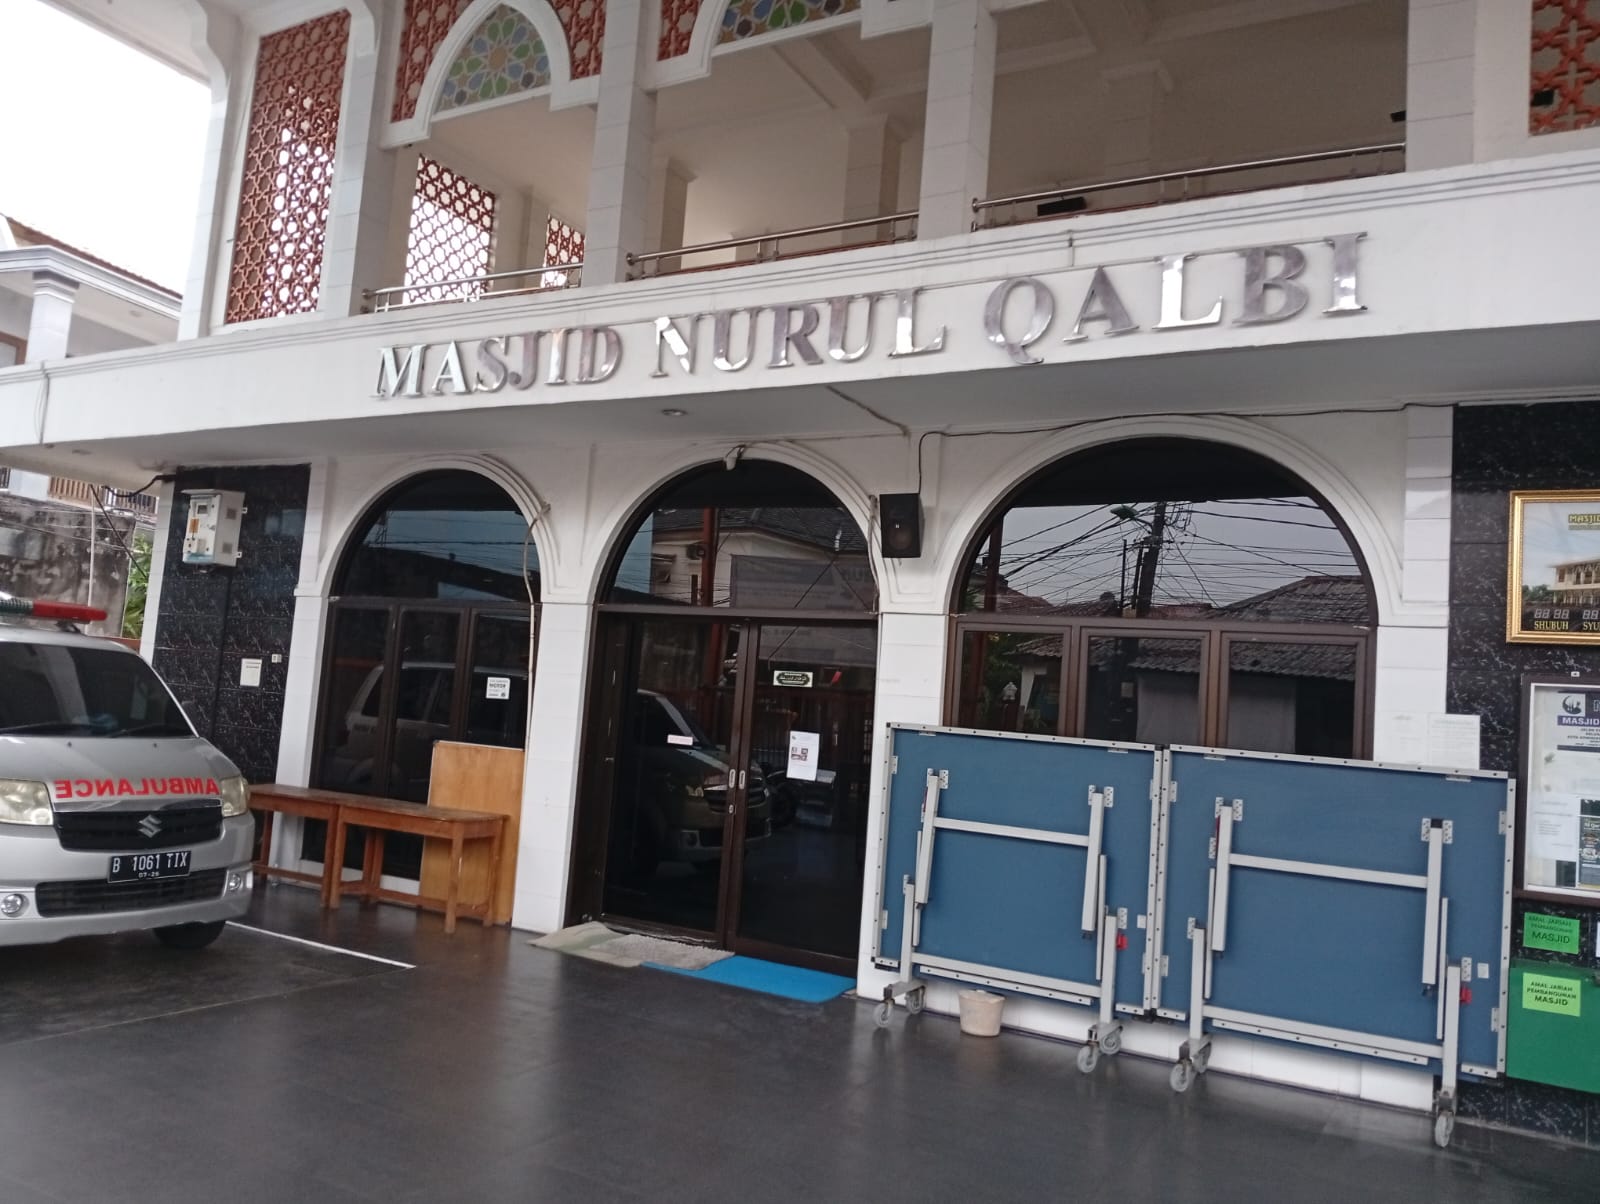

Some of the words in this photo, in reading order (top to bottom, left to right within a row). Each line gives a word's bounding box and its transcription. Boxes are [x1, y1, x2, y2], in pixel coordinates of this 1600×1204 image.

[370, 326, 623, 398] MASJID
[650, 288, 945, 378] NURUL
[983, 231, 1368, 365] QALBI
[1534, 620, 1569, 630] SHUBUH
[1562, 717, 1600, 726] MASJID
[112, 857, 121, 873] B
[133, 854, 160, 872] 1061
[166, 852, 188, 869] TIX
[1531, 931, 1570, 944] MASJID
[1530, 981, 1547, 989] AMAL
[1527, 987, 1577, 999] PEMBANGUNAN
[1534, 995, 1569, 1006] MASJID
